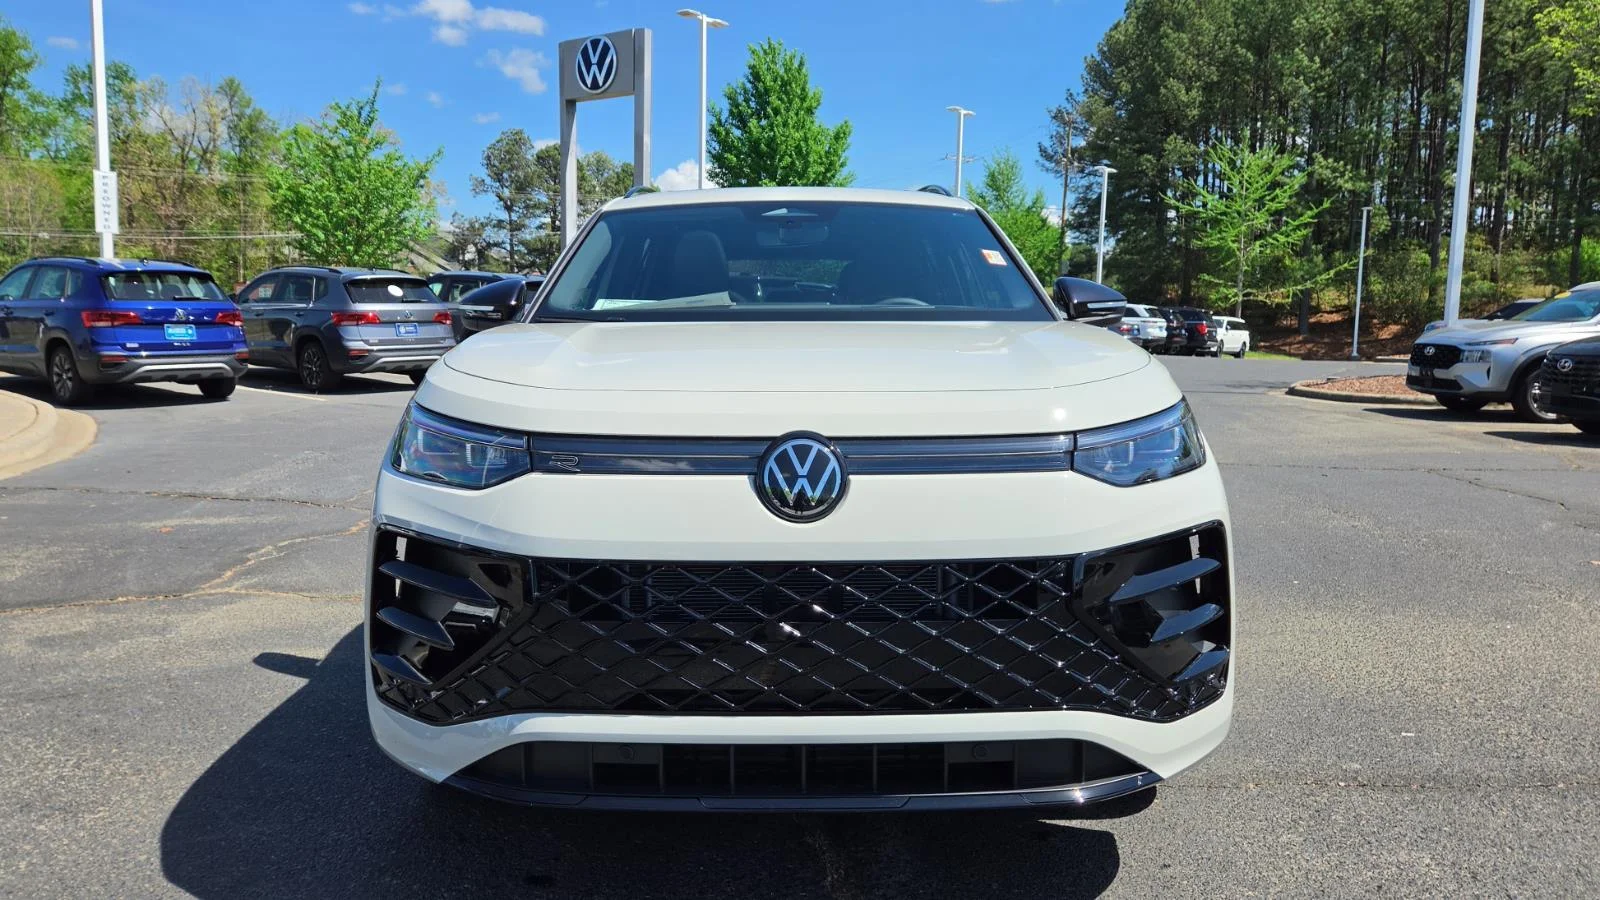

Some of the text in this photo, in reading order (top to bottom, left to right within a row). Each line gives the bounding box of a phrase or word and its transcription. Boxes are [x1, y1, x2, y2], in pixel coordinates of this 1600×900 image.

[577, 37, 615, 91] VW
[549, 455, 581, 471] R
[765, 440, 840, 512] VW
